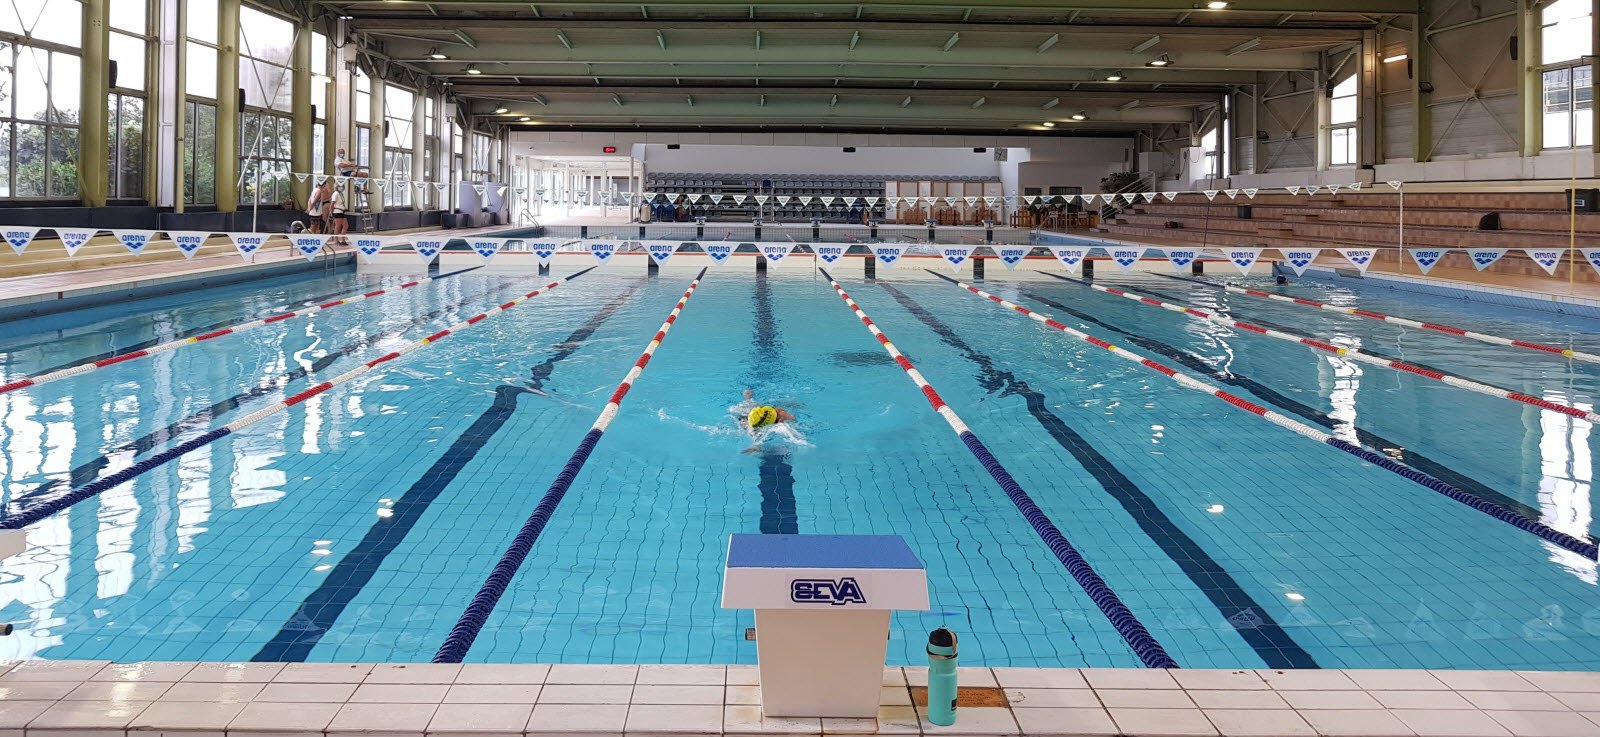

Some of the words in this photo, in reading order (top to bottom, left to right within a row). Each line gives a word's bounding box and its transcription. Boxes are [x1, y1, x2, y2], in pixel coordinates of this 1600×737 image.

[7, 231, 29, 239] arena
[64, 232, 87, 241] arena
[122, 234, 145, 242] arena
[297, 238, 320, 246] arena
[358, 239, 380, 247] arena
[650, 245, 672, 253] arena
[877, 247, 899, 255] arena
[1059, 250, 1081, 258] arena
[1231, 251, 1253, 259] arena
[1534, 252, 1557, 260] arena
[793, 579, 863, 603] SEVA
